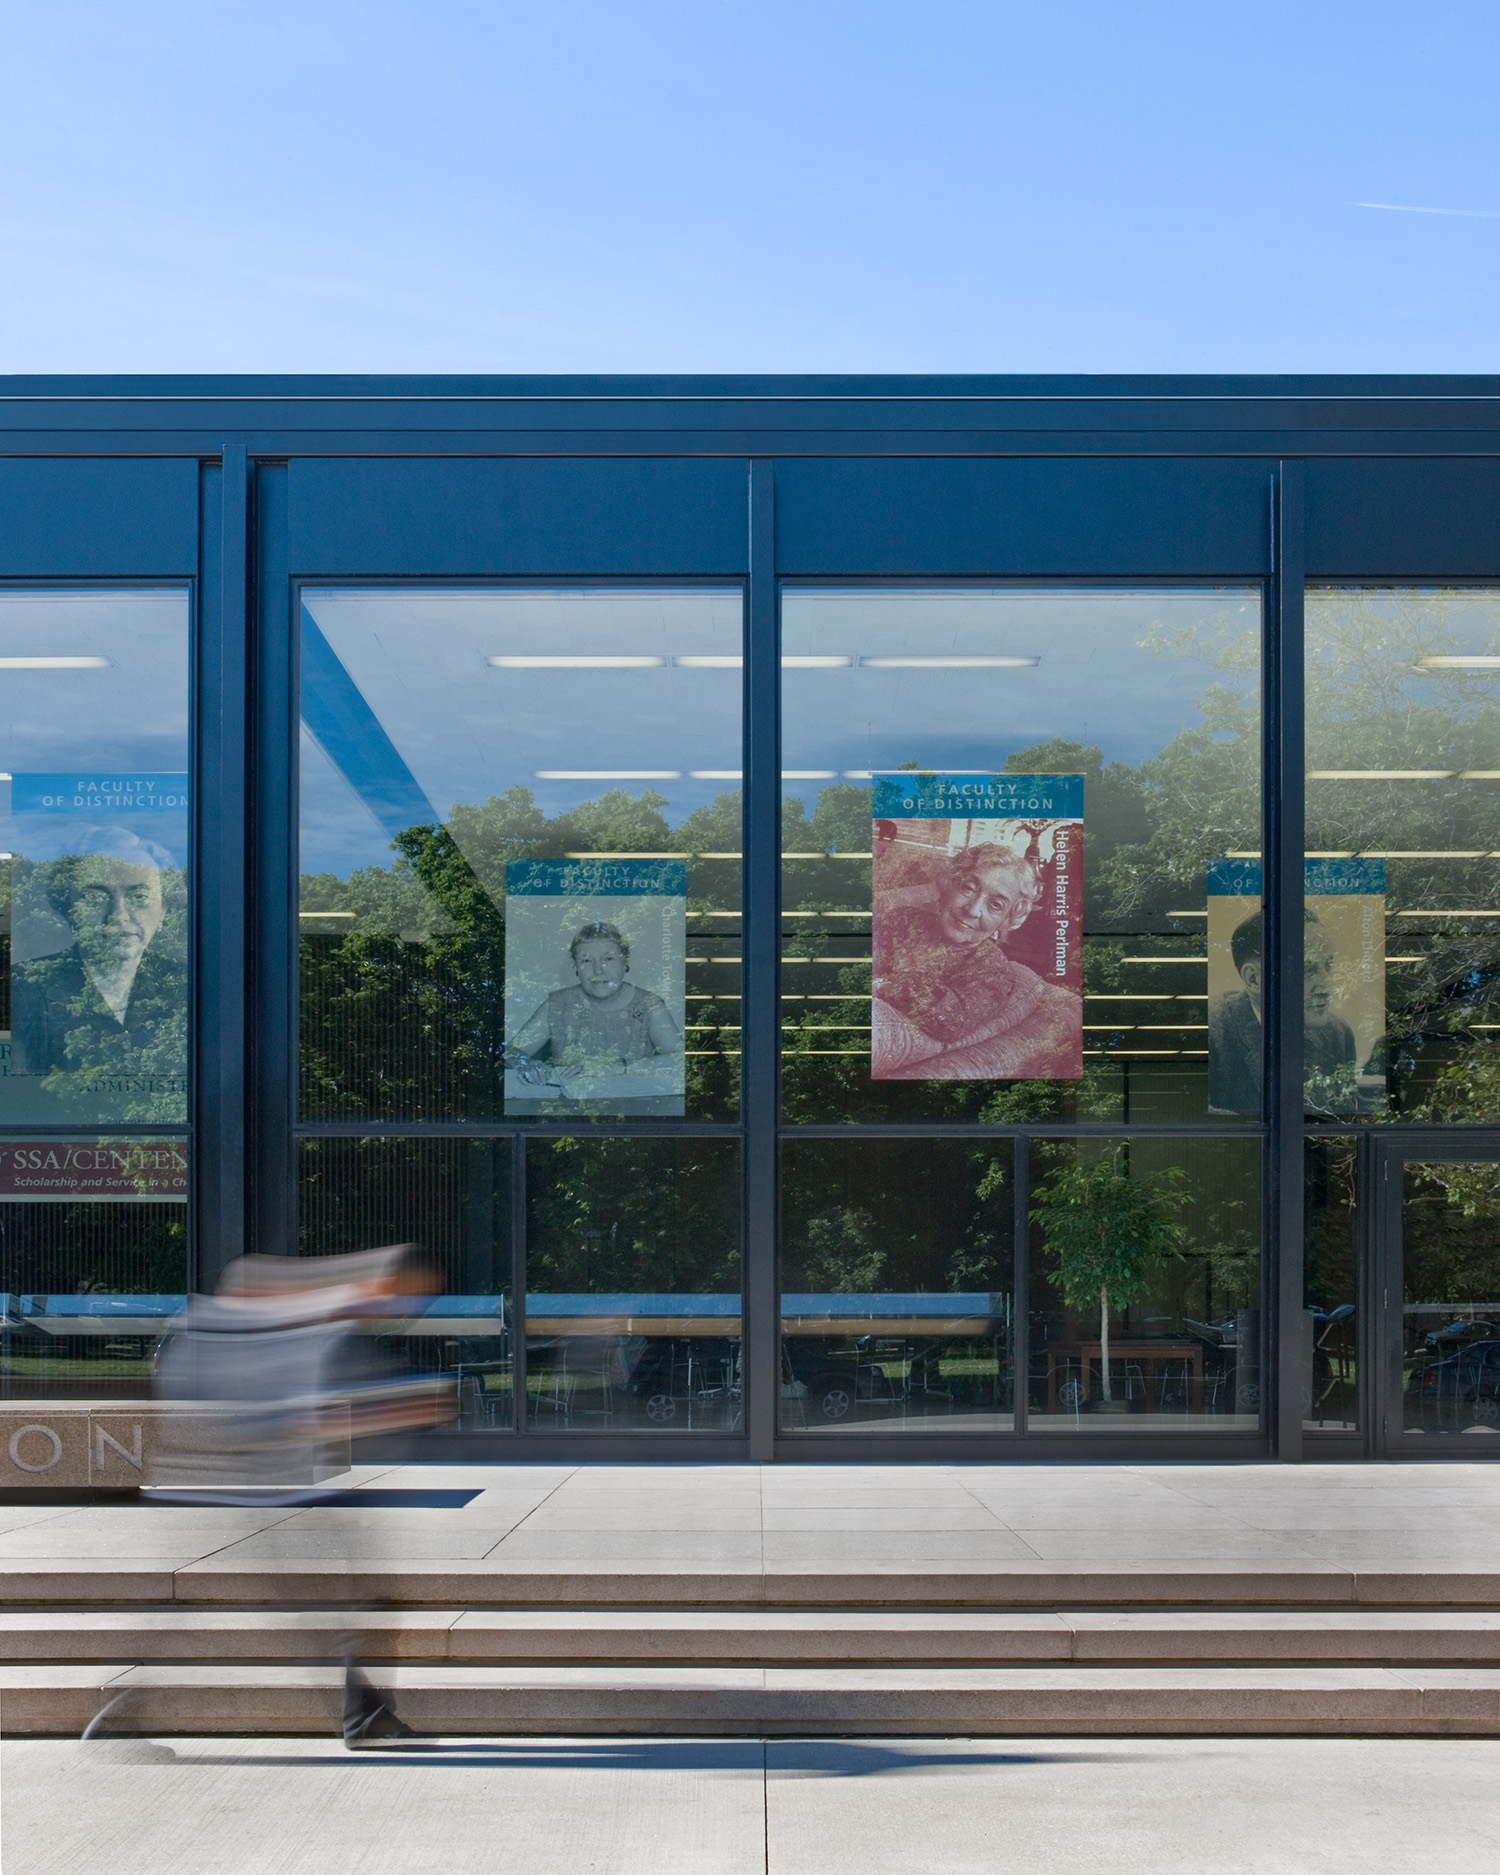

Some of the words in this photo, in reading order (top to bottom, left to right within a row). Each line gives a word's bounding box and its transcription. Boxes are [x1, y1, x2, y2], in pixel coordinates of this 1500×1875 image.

[78, 781, 156, 792] FACULTY
[938, 784, 1018, 795] FACULTY
[42, 795, 65, 807] OF
[902, 798, 926, 810] OF
[935, 798, 1053, 810] DISTINCTION
[1056, 831, 1070, 870] Helen
[563, 866, 630, 876] FACULTY
[533, 878, 552, 888] OF
[560, 878, 660, 889] DISTINCTION
[1233, 879, 1253, 889] OF
[1304, 878, 1360, 888] NCTION
[1056, 875, 1070, 916] Harris
[662, 906, 673, 961] Charlotte
[1056, 920, 1070, 976] Perlman
[662, 965, 673, 1001] Towle
[14, 1177, 79, 1188] Scholarship
[82, 1177, 103, 1187] and
[105, 1177, 145, 1187] Service
[149, 1177, 159, 1187] in
[162, 1179, 169, 1187] a
[172, 1177, 188, 1187] Ch
